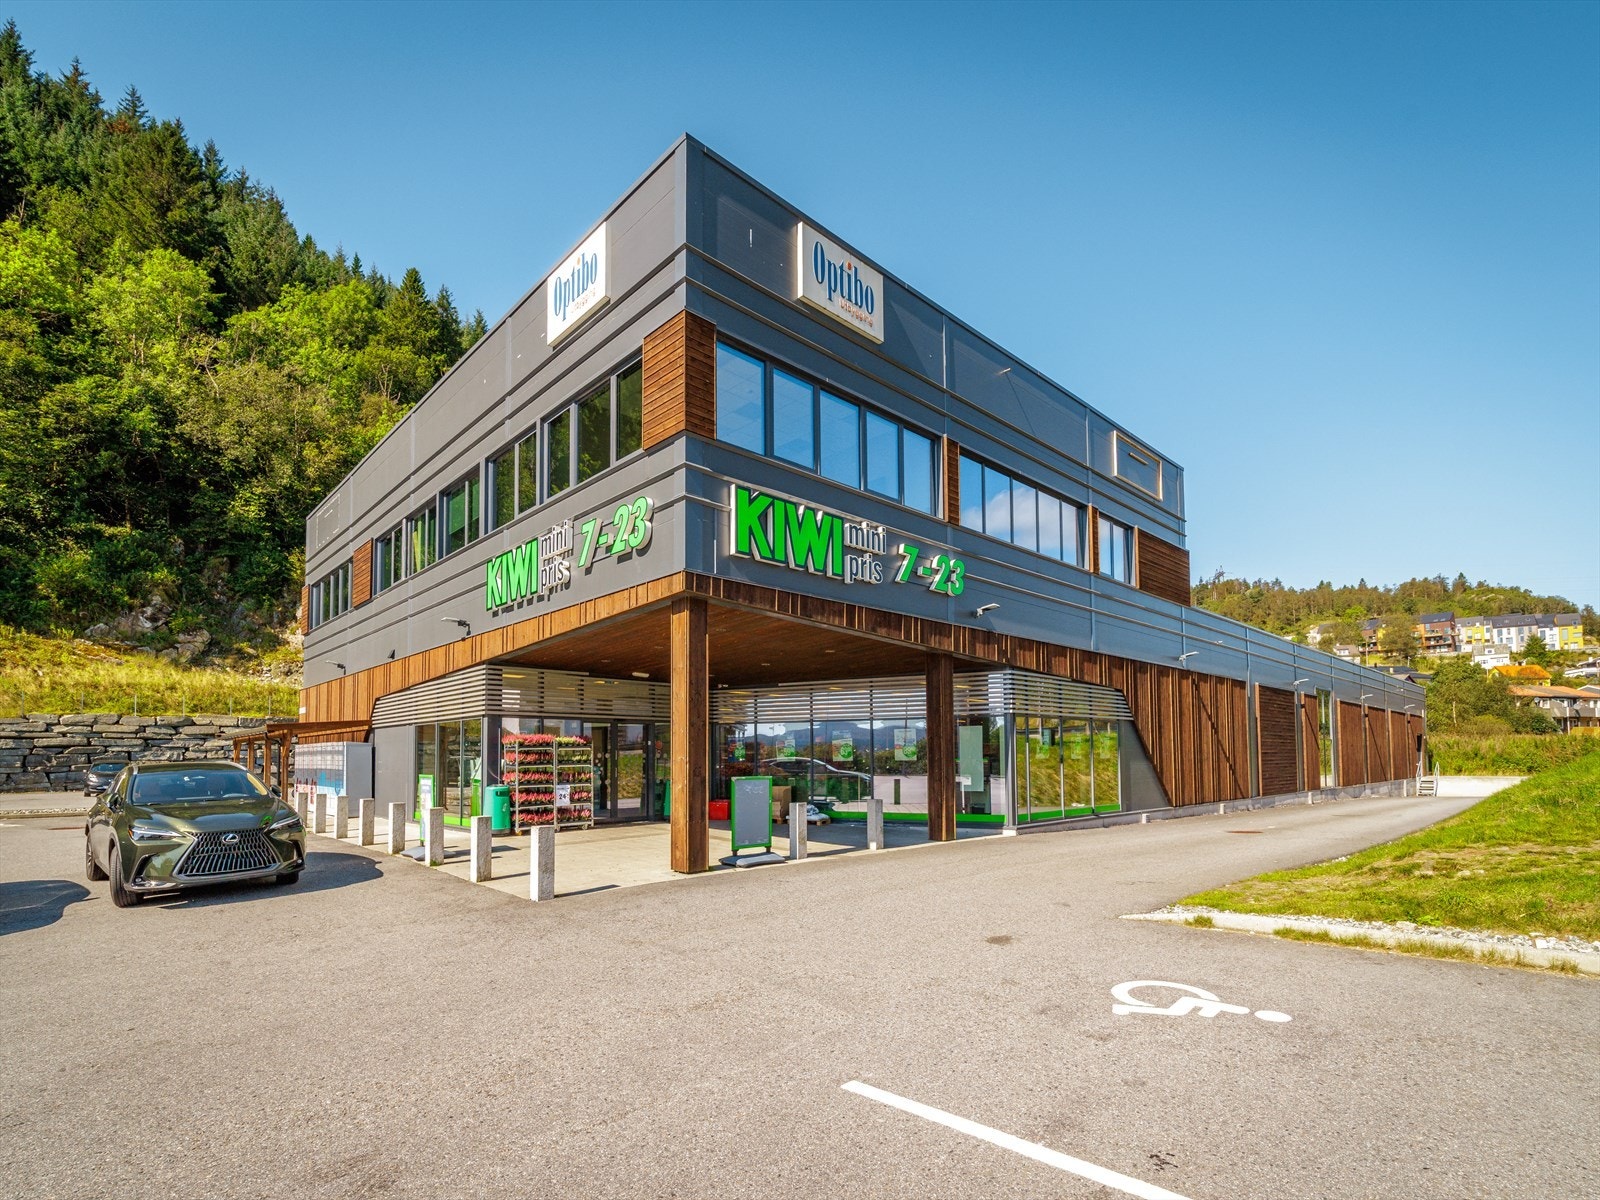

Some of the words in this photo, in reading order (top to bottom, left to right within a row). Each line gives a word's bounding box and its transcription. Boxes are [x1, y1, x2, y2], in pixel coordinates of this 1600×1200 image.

[553, 252, 598, 322] Optibo
[812, 240, 875, 315] Optibo
[541, 519, 570, 558] mini
[735, 486, 844, 577] KIWI
[846, 522, 886, 555] mini
[486, 537, 539, 611] KIWI
[540, 558, 566, 595] pris
[846, 553, 883, 584] pris
